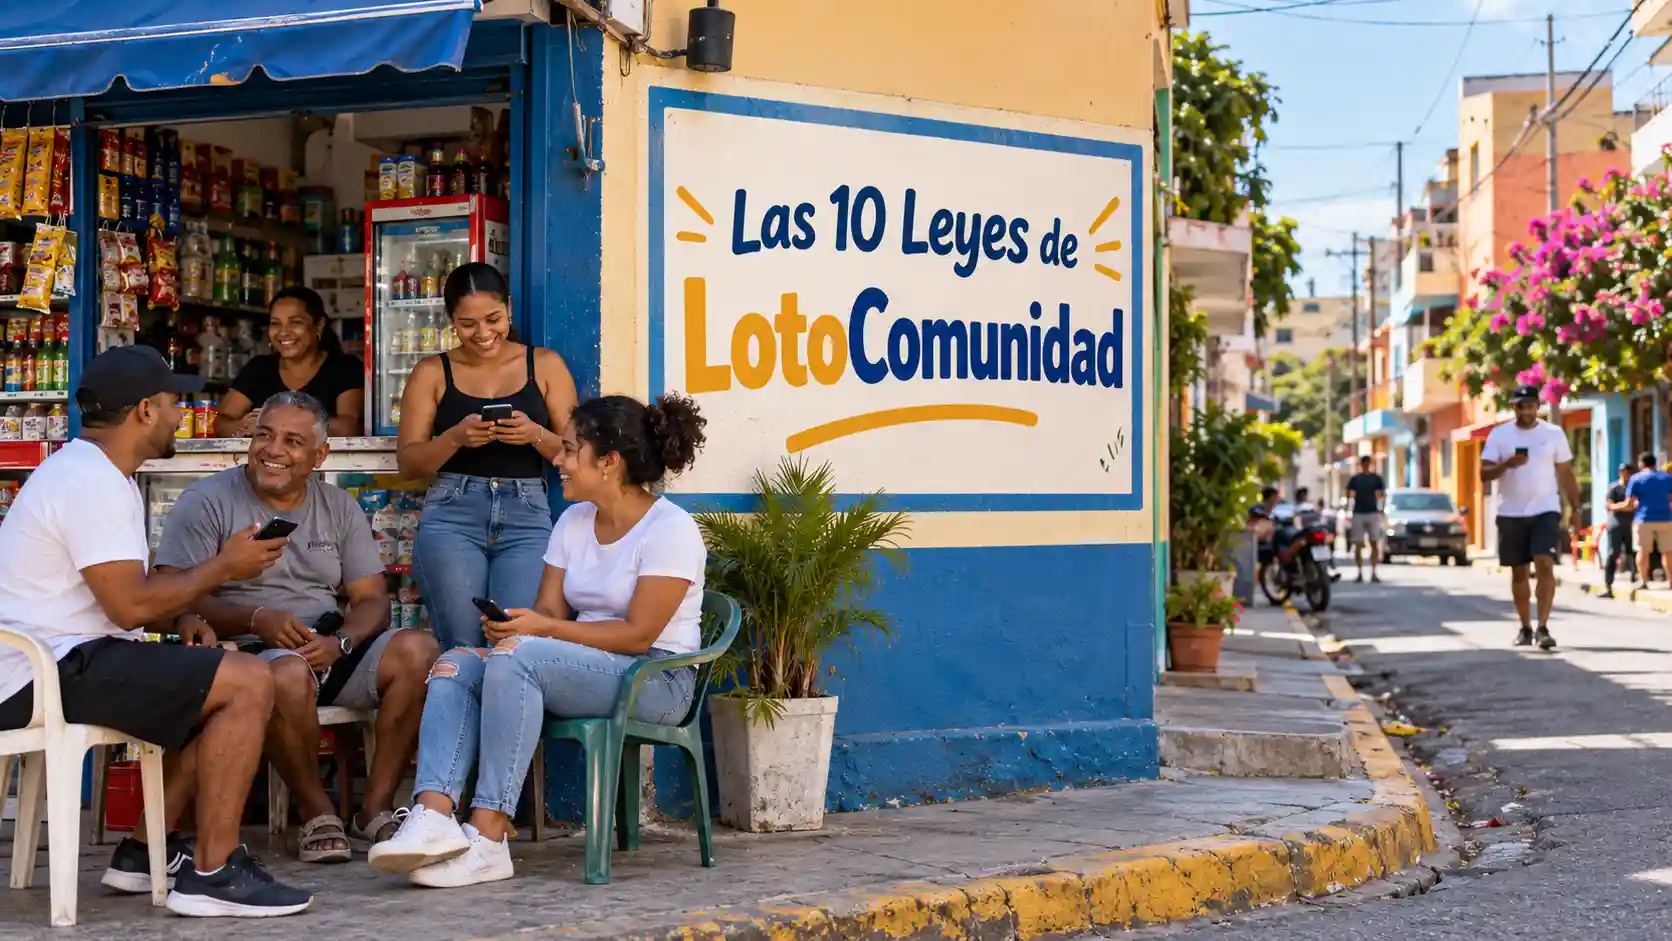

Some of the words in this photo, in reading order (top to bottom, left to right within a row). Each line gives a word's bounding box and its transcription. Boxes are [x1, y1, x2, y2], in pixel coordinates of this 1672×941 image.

[732, 189, 816, 255] Las
[830, 185, 886, 252] 10
[902, 188, 1029, 278] Leyes
[1040, 217, 1078, 268] de
[684, 277, 1123, 394] LotoComunidad
